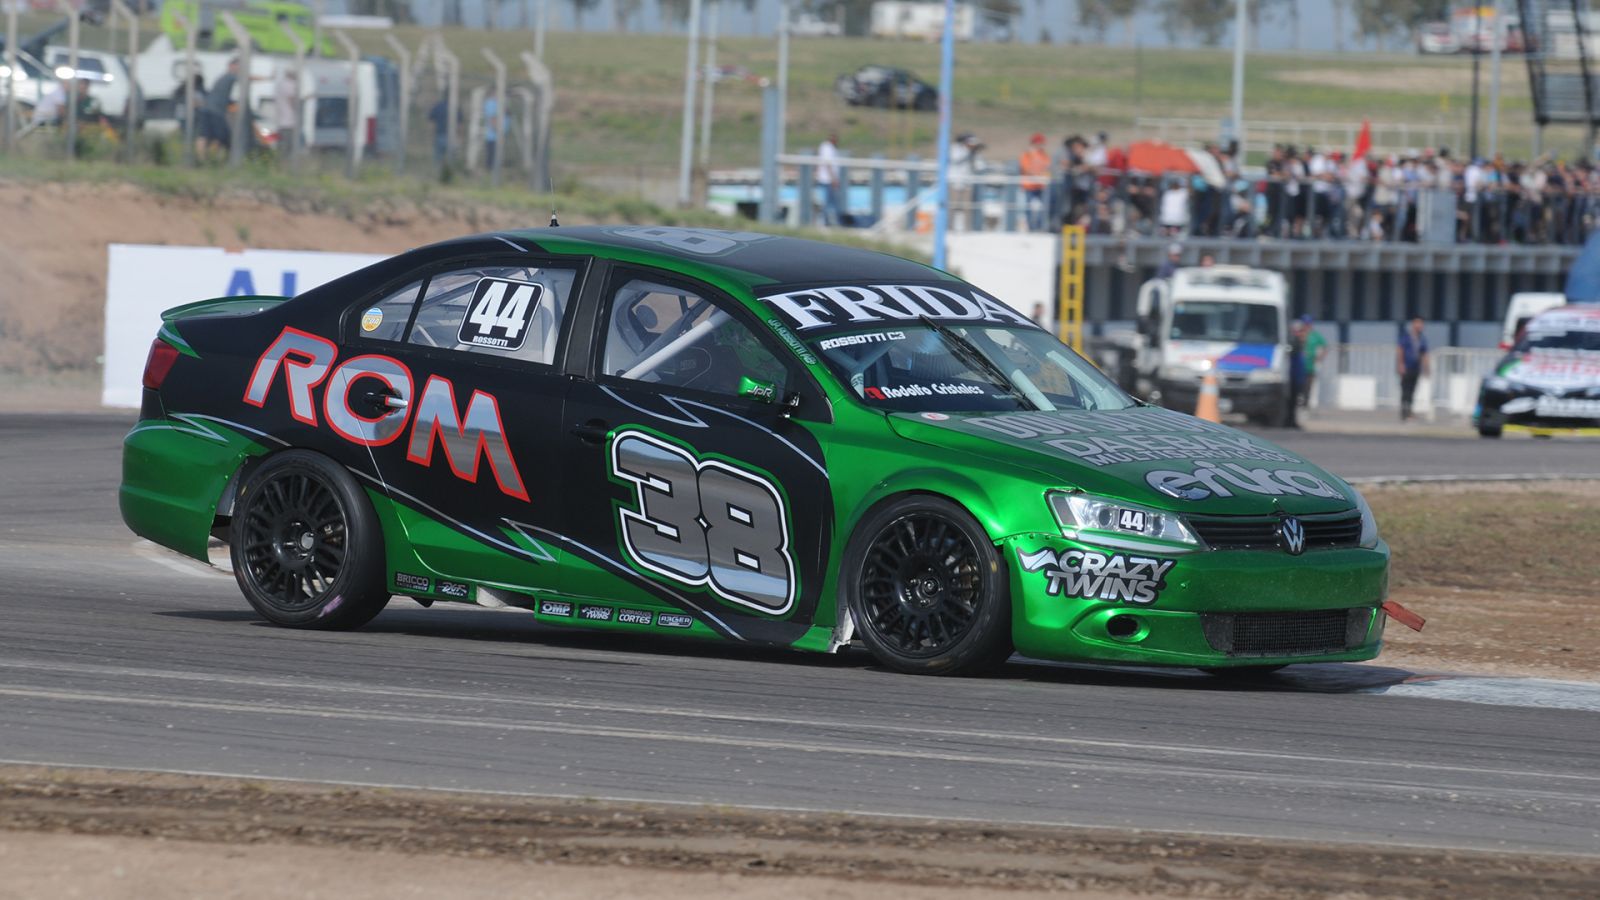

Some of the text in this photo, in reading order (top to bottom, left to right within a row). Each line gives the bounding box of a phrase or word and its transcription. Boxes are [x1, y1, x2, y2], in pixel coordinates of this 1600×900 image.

[469, 281, 535, 339] 44
[757, 284, 1043, 330] FRIDA
[472, 335, 508, 347] ROSSOTTI
[820, 331, 906, 351] ROSSOTTI C3
[881, 383, 984, 399] Rodolfo Cristales
[243, 325, 532, 503] ROM
[961, 411, 1231, 439] DON SATUR
[1041, 434, 1260, 457] DAEBAK
[1084, 448, 1302, 466] MULTISERVICIOS
[612, 430, 795, 615] 38
[1120, 510, 1144, 530] 44
[1059, 551, 1173, 582] CRAZY
[397, 573, 429, 586] BRICCO
[1047, 571, 1157, 602] TWINS
[542, 603, 571, 614] OMP
[586, 611, 609, 620] TWINS
[588, 606, 612, 615] CRAZY
[618, 615, 651, 625] CORTES
